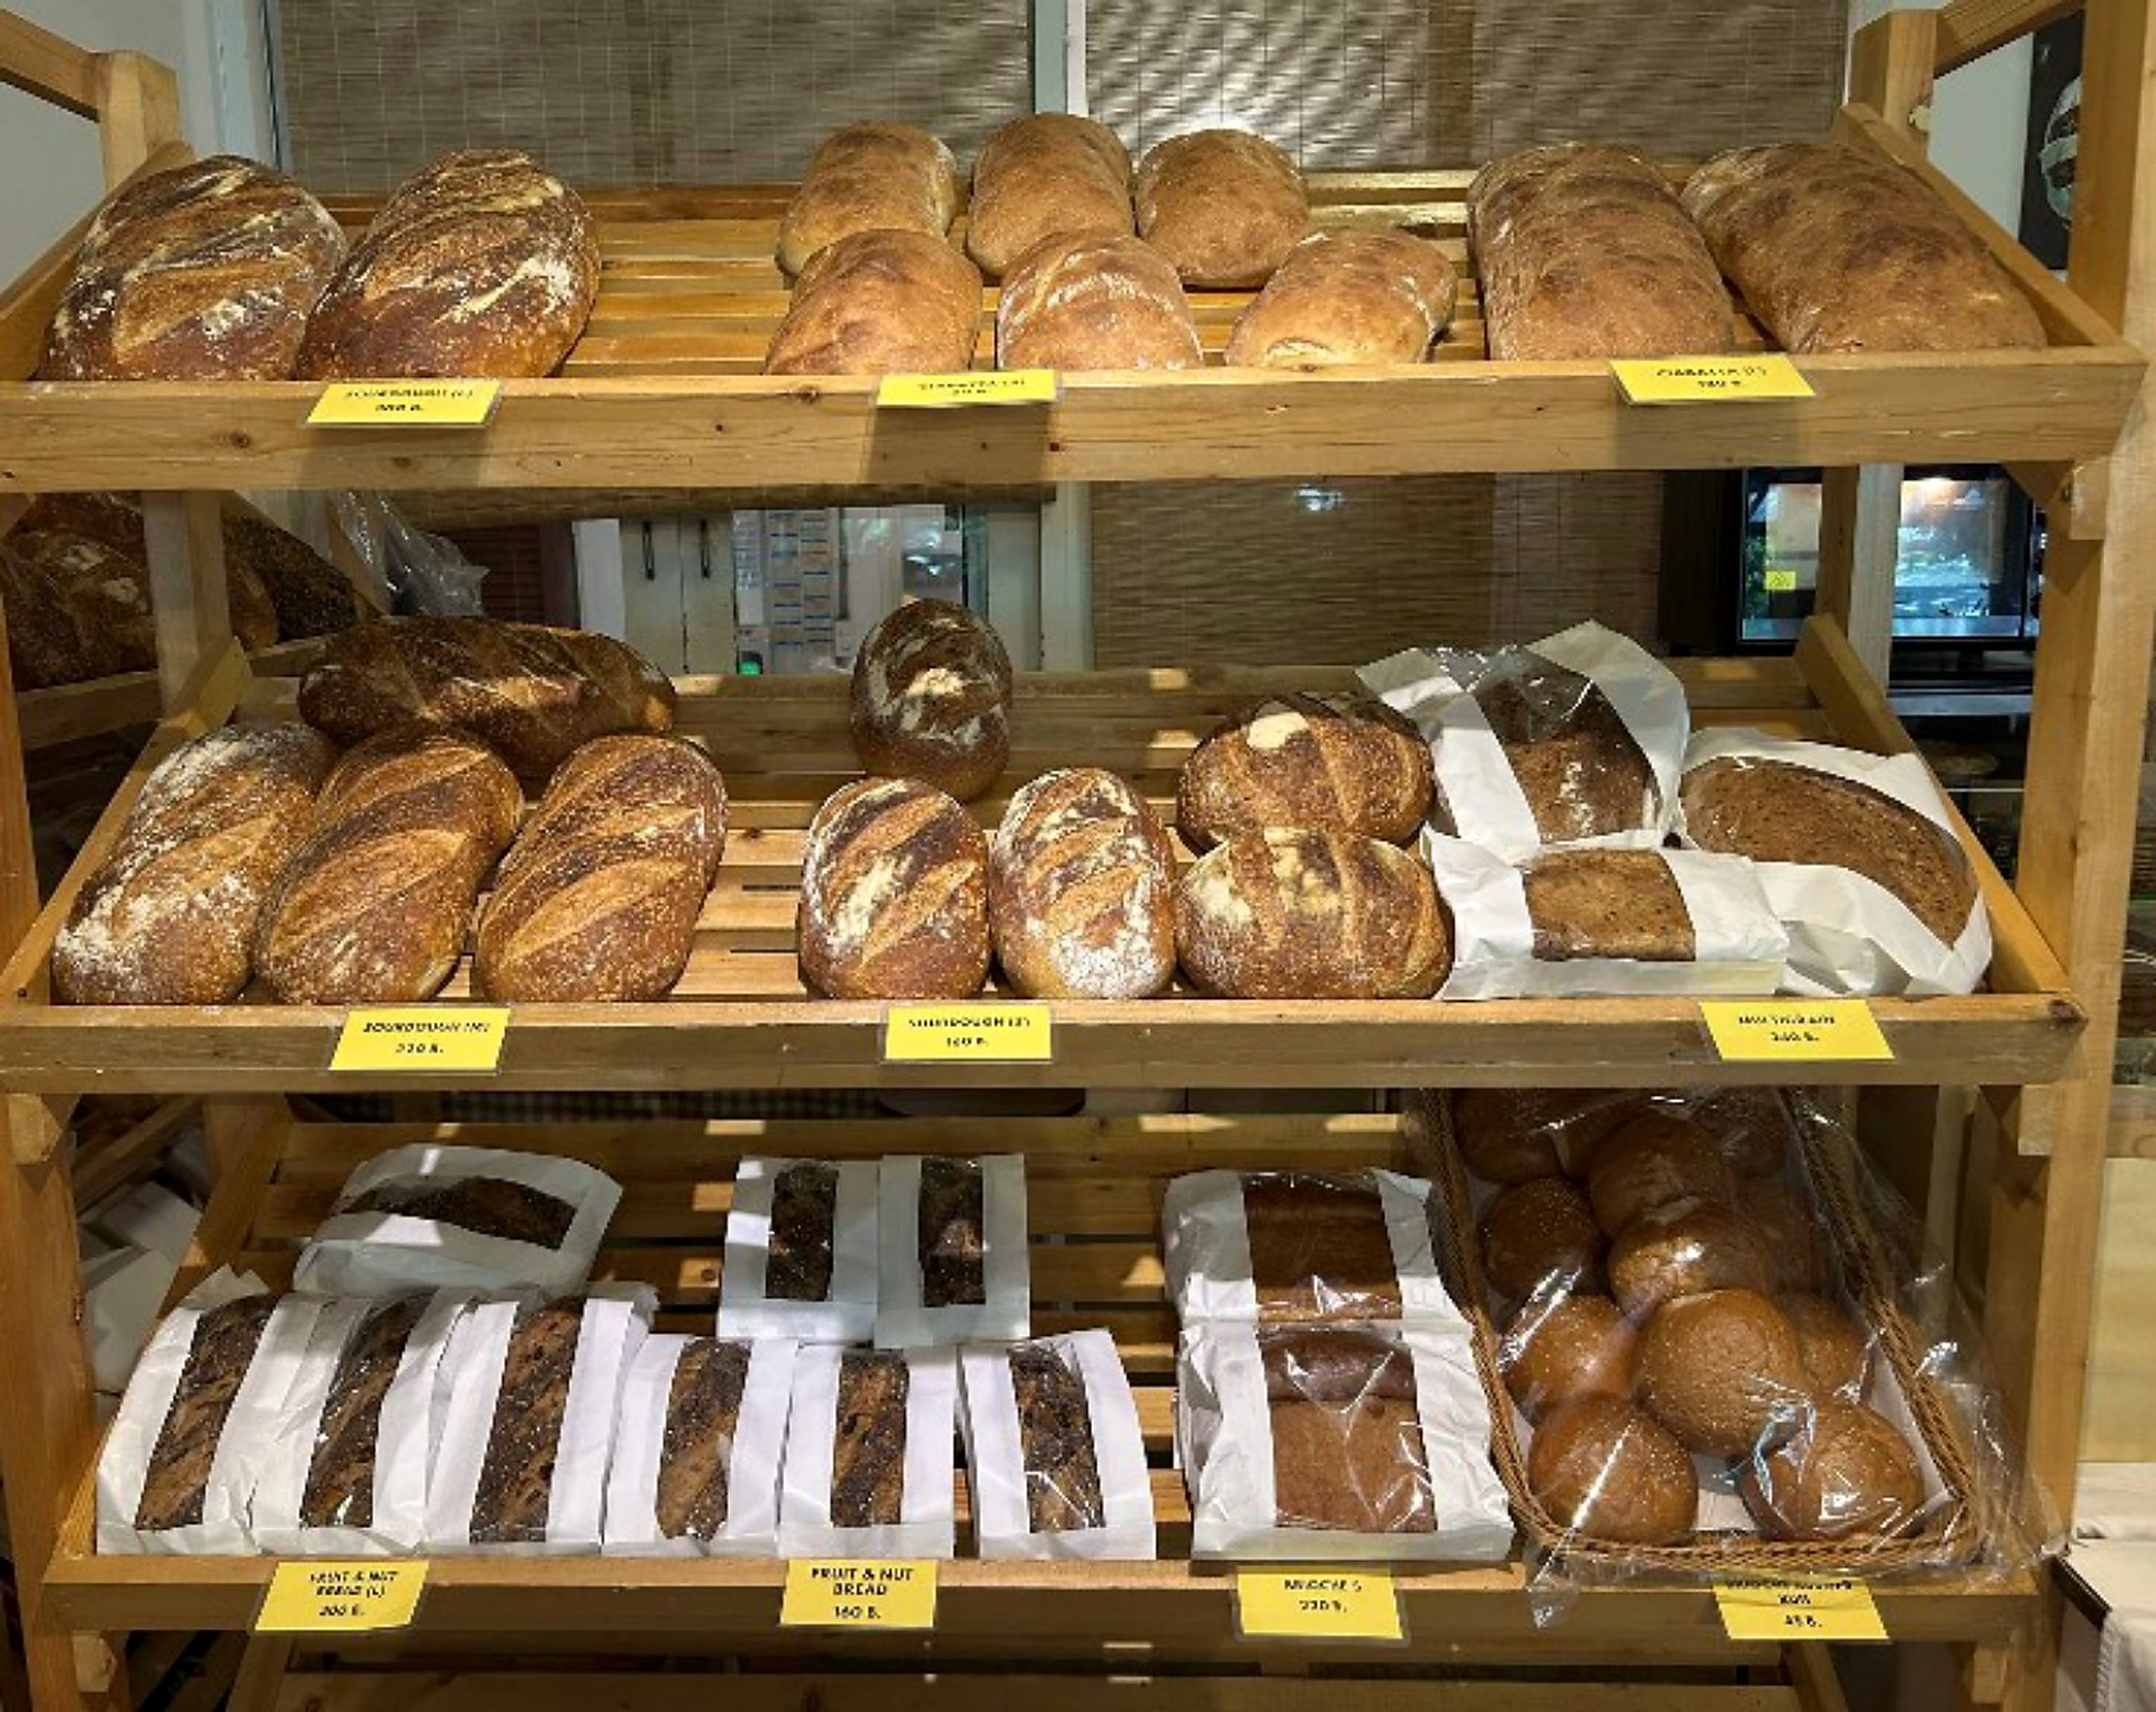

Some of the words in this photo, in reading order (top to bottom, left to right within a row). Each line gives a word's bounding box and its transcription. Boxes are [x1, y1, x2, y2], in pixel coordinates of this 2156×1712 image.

[811, 1567, 858, 1581] FRUIT
[862, 1567, 876, 1580] &
[879, 1567, 914, 1581] NUT
[832, 1583, 887, 1596] BREAD
[834, 1605, 862, 1619] 160
[867, 1606, 881, 1619] B.
